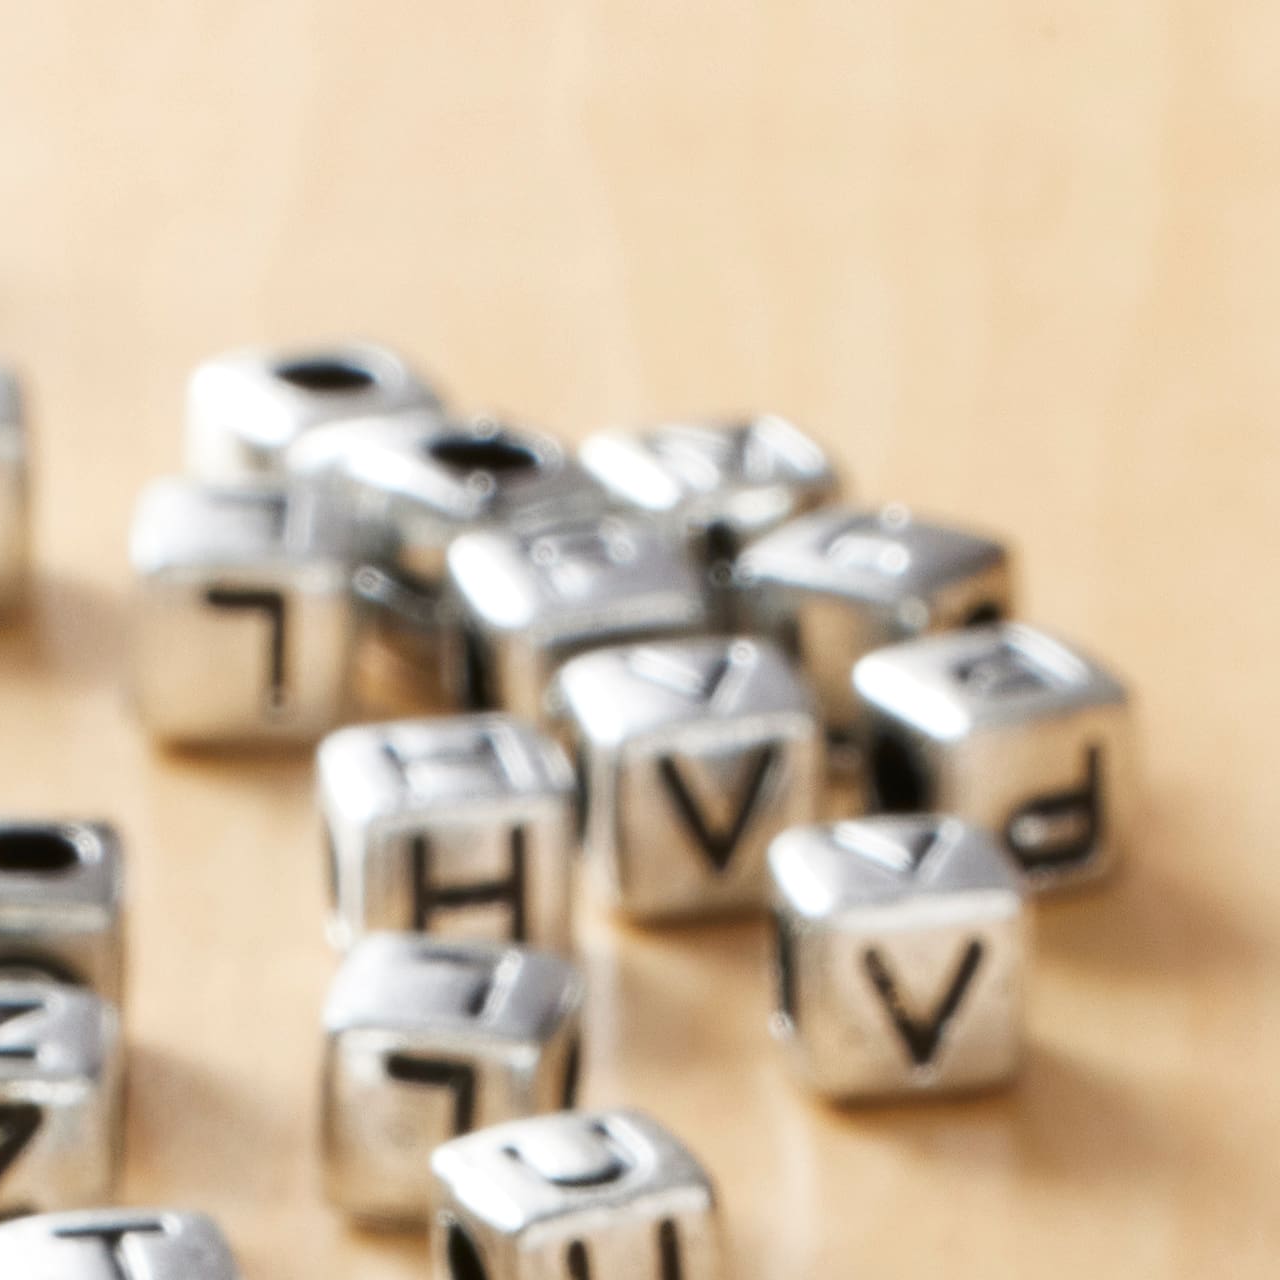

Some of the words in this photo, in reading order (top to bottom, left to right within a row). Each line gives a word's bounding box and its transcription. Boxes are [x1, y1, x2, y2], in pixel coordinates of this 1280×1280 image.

[656, 743, 780, 873] V
[411, 823, 528, 946] H
[862, 936, 985, 1066] V
[500, 1111, 658, 1188] U
